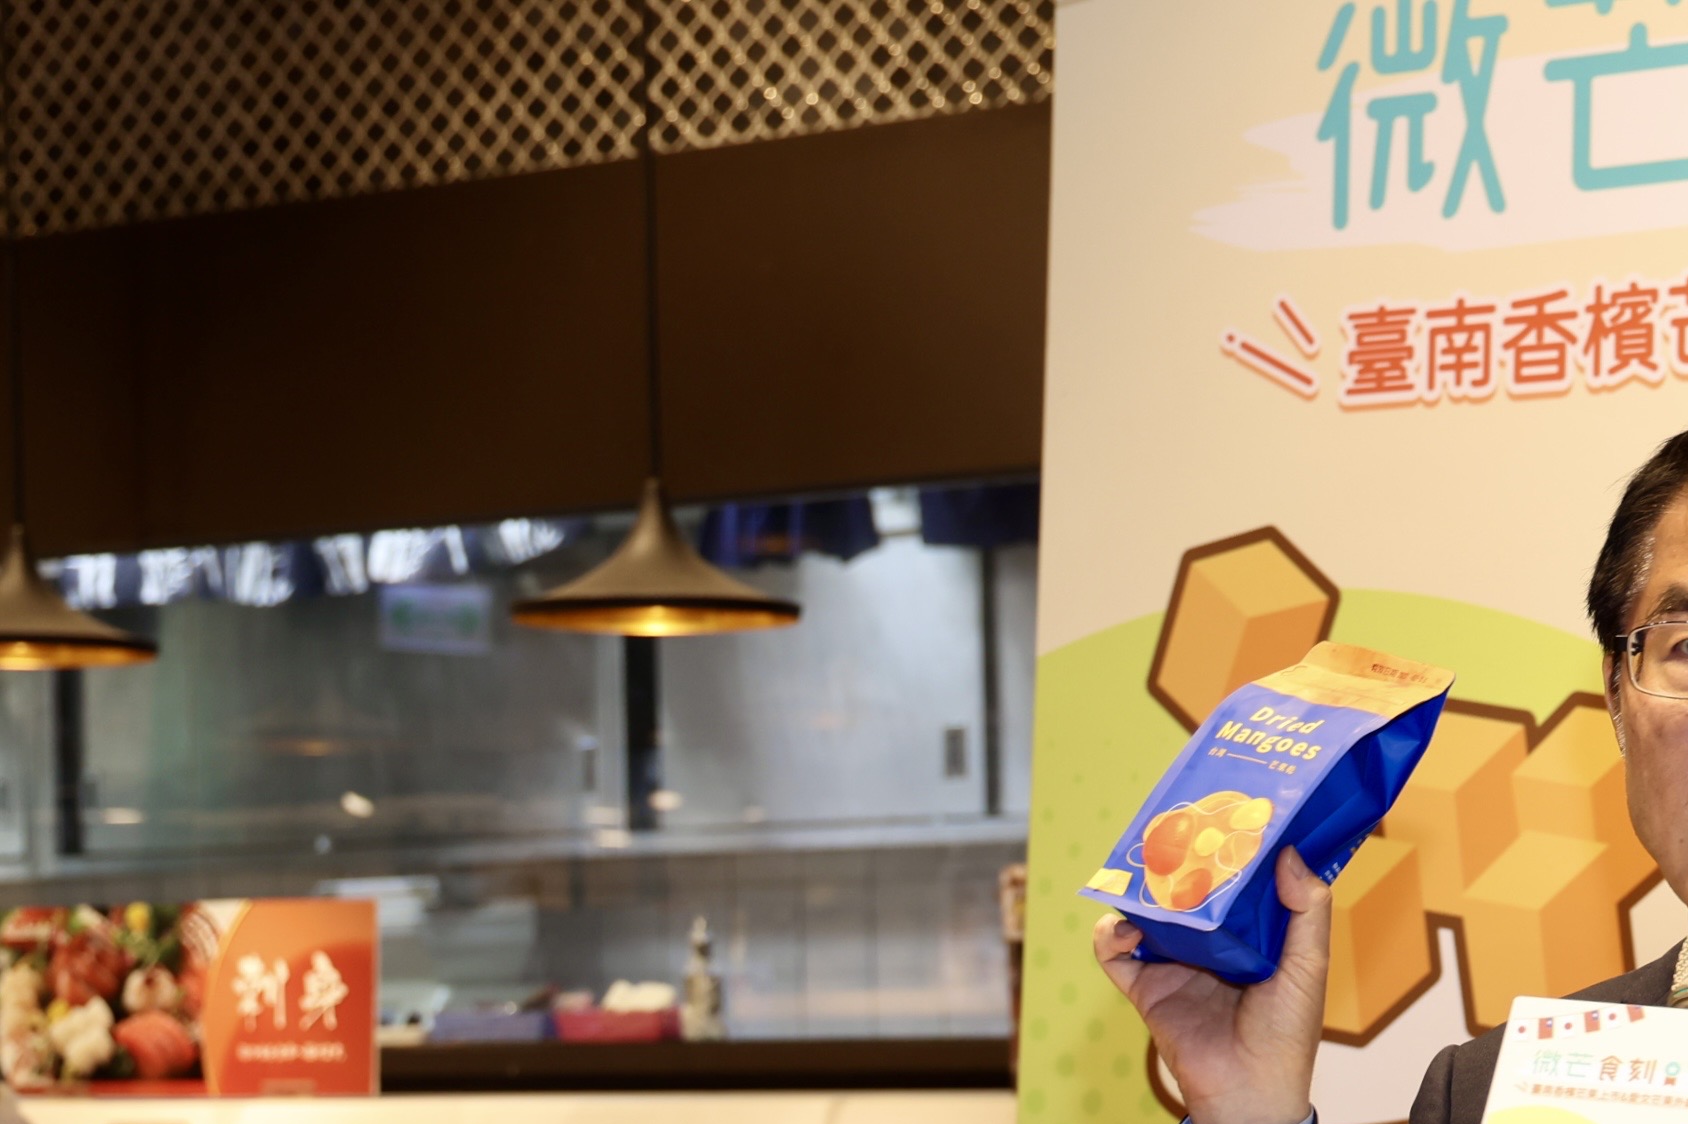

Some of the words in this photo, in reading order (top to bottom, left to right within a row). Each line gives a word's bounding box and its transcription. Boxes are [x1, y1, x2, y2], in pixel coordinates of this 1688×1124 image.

[1249, 706, 1325, 734] Dried
[1215, 720, 1322, 760] Mangoes
[1532, 1048, 1657, 1085] 微芒食刻
